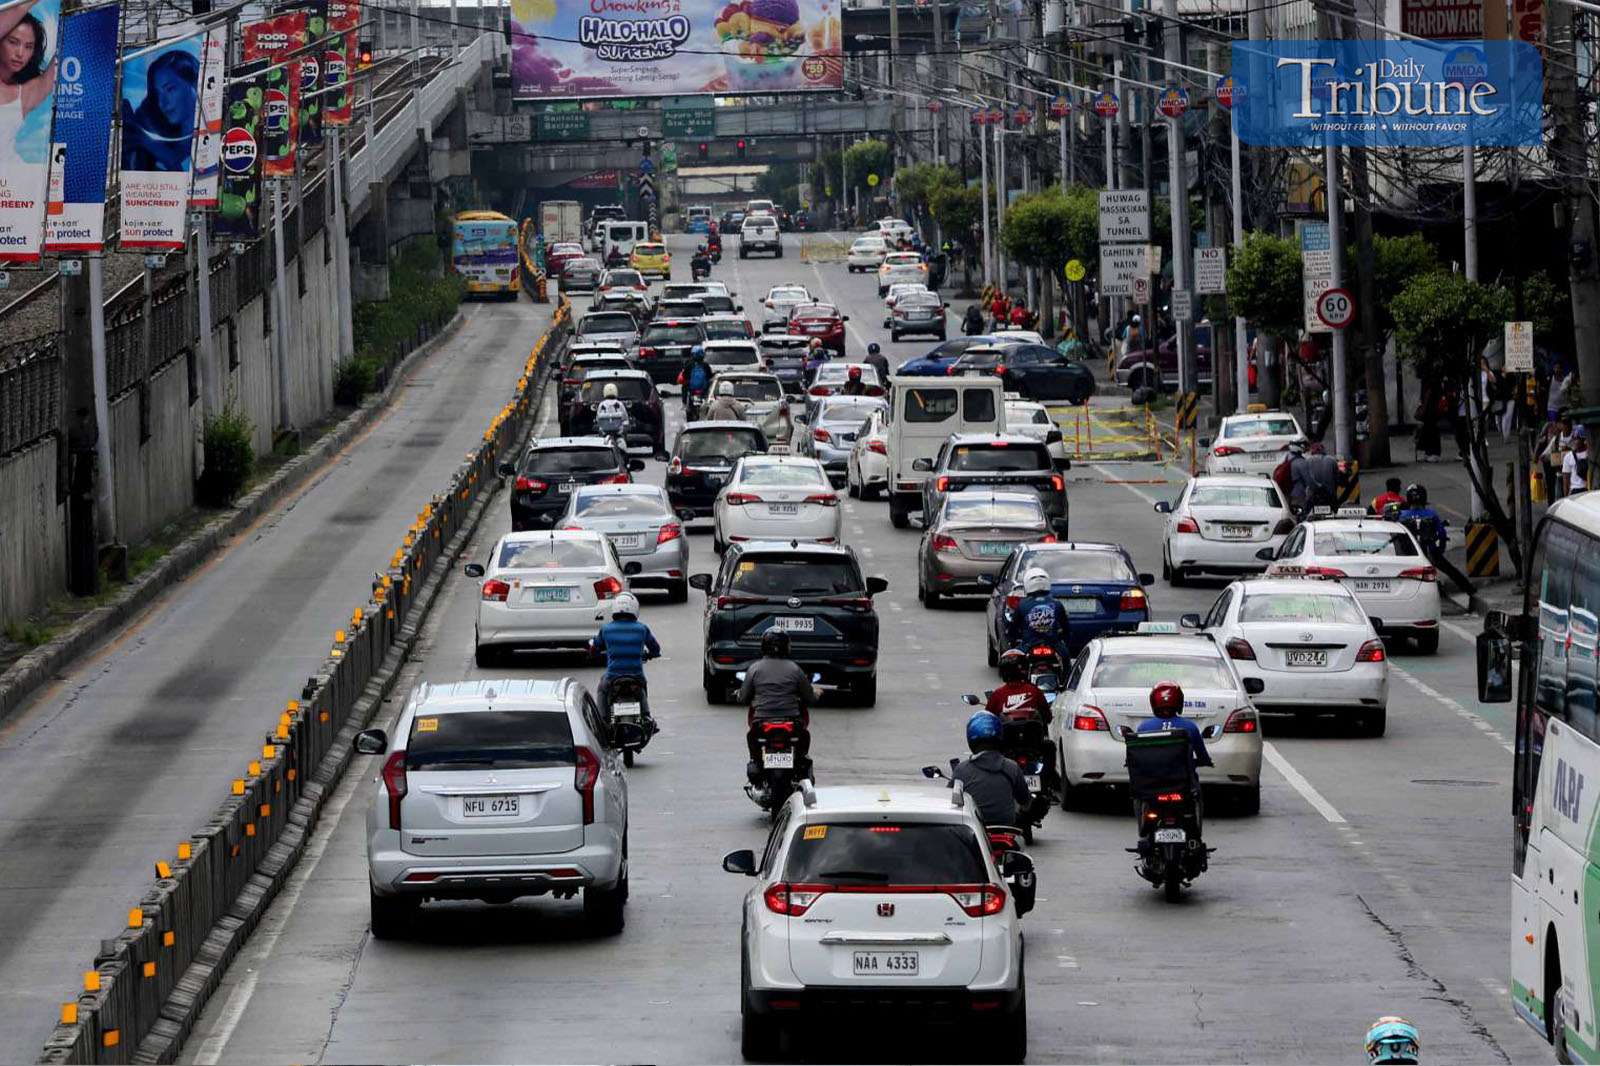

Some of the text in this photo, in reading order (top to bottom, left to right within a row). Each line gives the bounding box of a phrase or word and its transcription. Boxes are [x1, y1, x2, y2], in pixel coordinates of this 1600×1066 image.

[581, 16, 690, 43] HALO-HALO
[598, 41, 675, 60] SUPREME
[1159, 99, 1186, 108] MMDA
[222, 144, 256, 155] PEPSI
[1106, 194, 1141, 202] HUWAG
[1118, 216, 1130, 225] SA
[56, 229, 91, 239] protect
[143, 228, 174, 237] protect
[1107, 227, 1143, 236] TUNNEL
[1201, 250, 1219, 259] NO
[1113, 261, 1138, 269] NATIN
[1103, 284, 1129, 293] SERVICE
[1312, 280, 1329, 289] NO
[1325, 297, 1348, 312] 60
[1007, 693, 1027, 705] NIKE
[1553, 758, 1584, 824] ALPS
[465, 800, 517, 812] NFU 6715
[856, 957, 917, 970] NAA 4333
